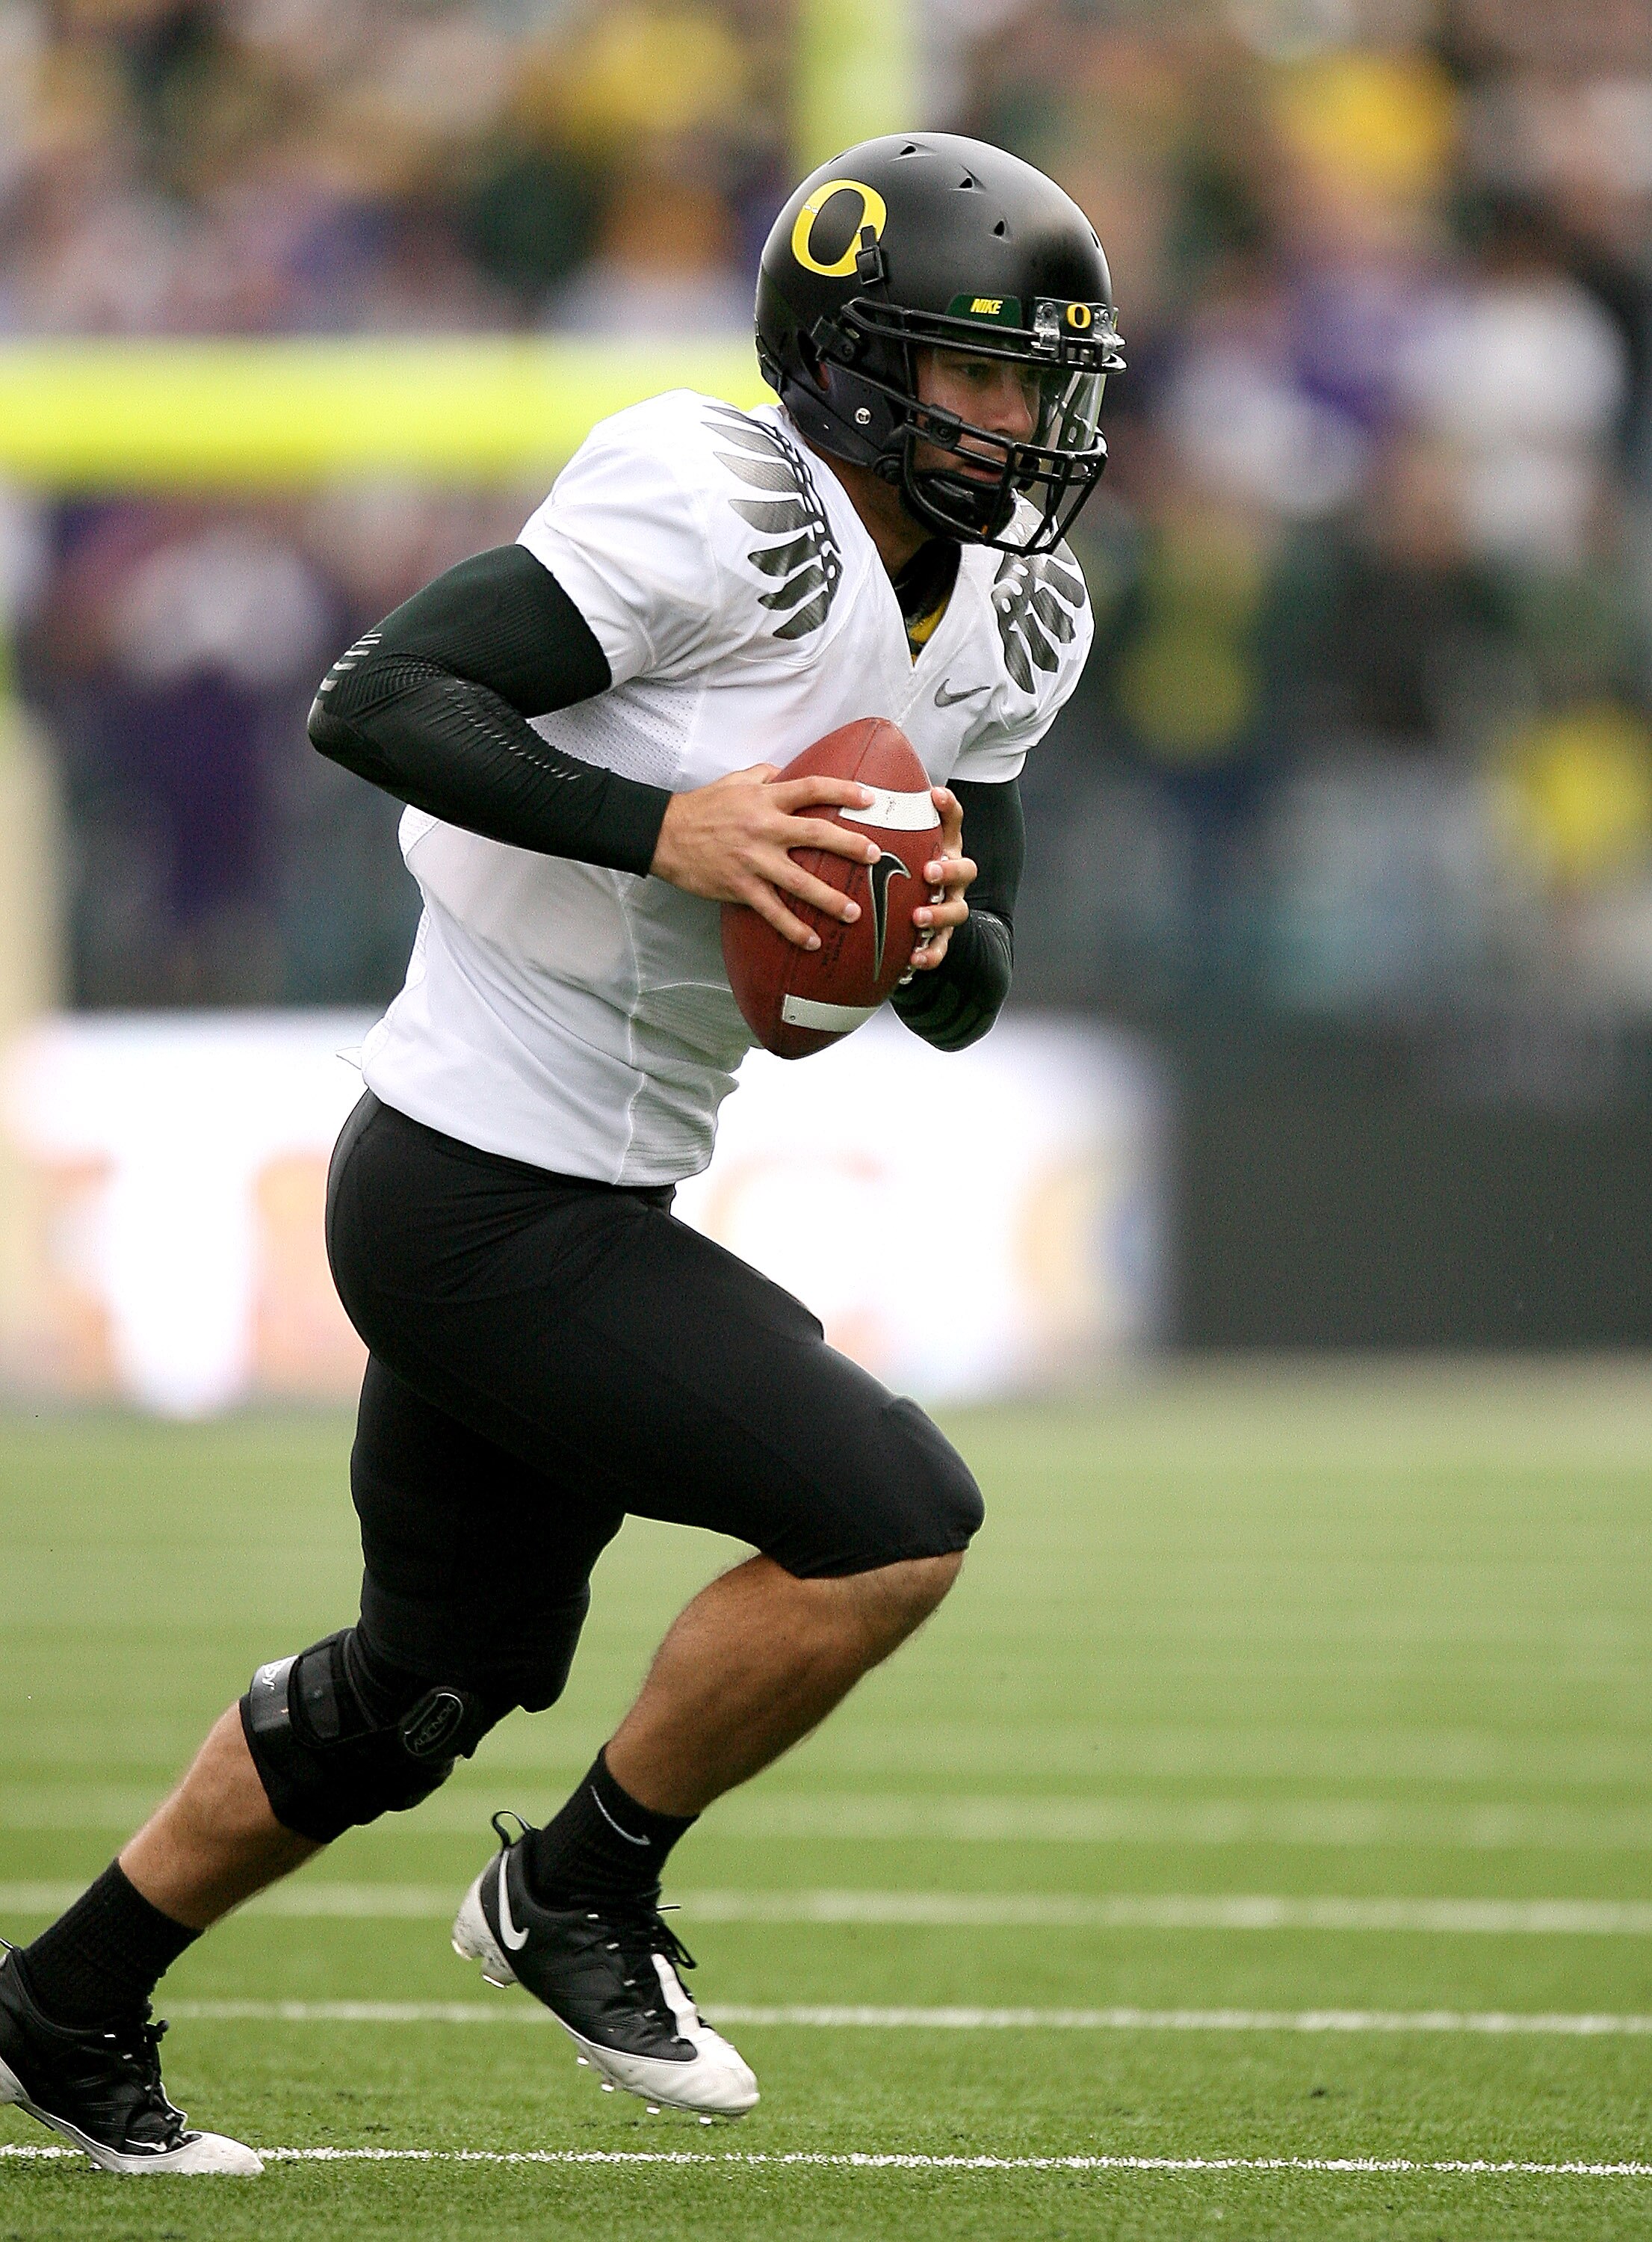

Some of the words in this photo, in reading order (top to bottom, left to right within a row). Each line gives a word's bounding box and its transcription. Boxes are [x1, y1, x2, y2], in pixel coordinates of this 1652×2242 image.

[792, 179, 887, 277] O
[971, 298, 1003, 315] NIKE
[1066, 303, 1092, 329] O
